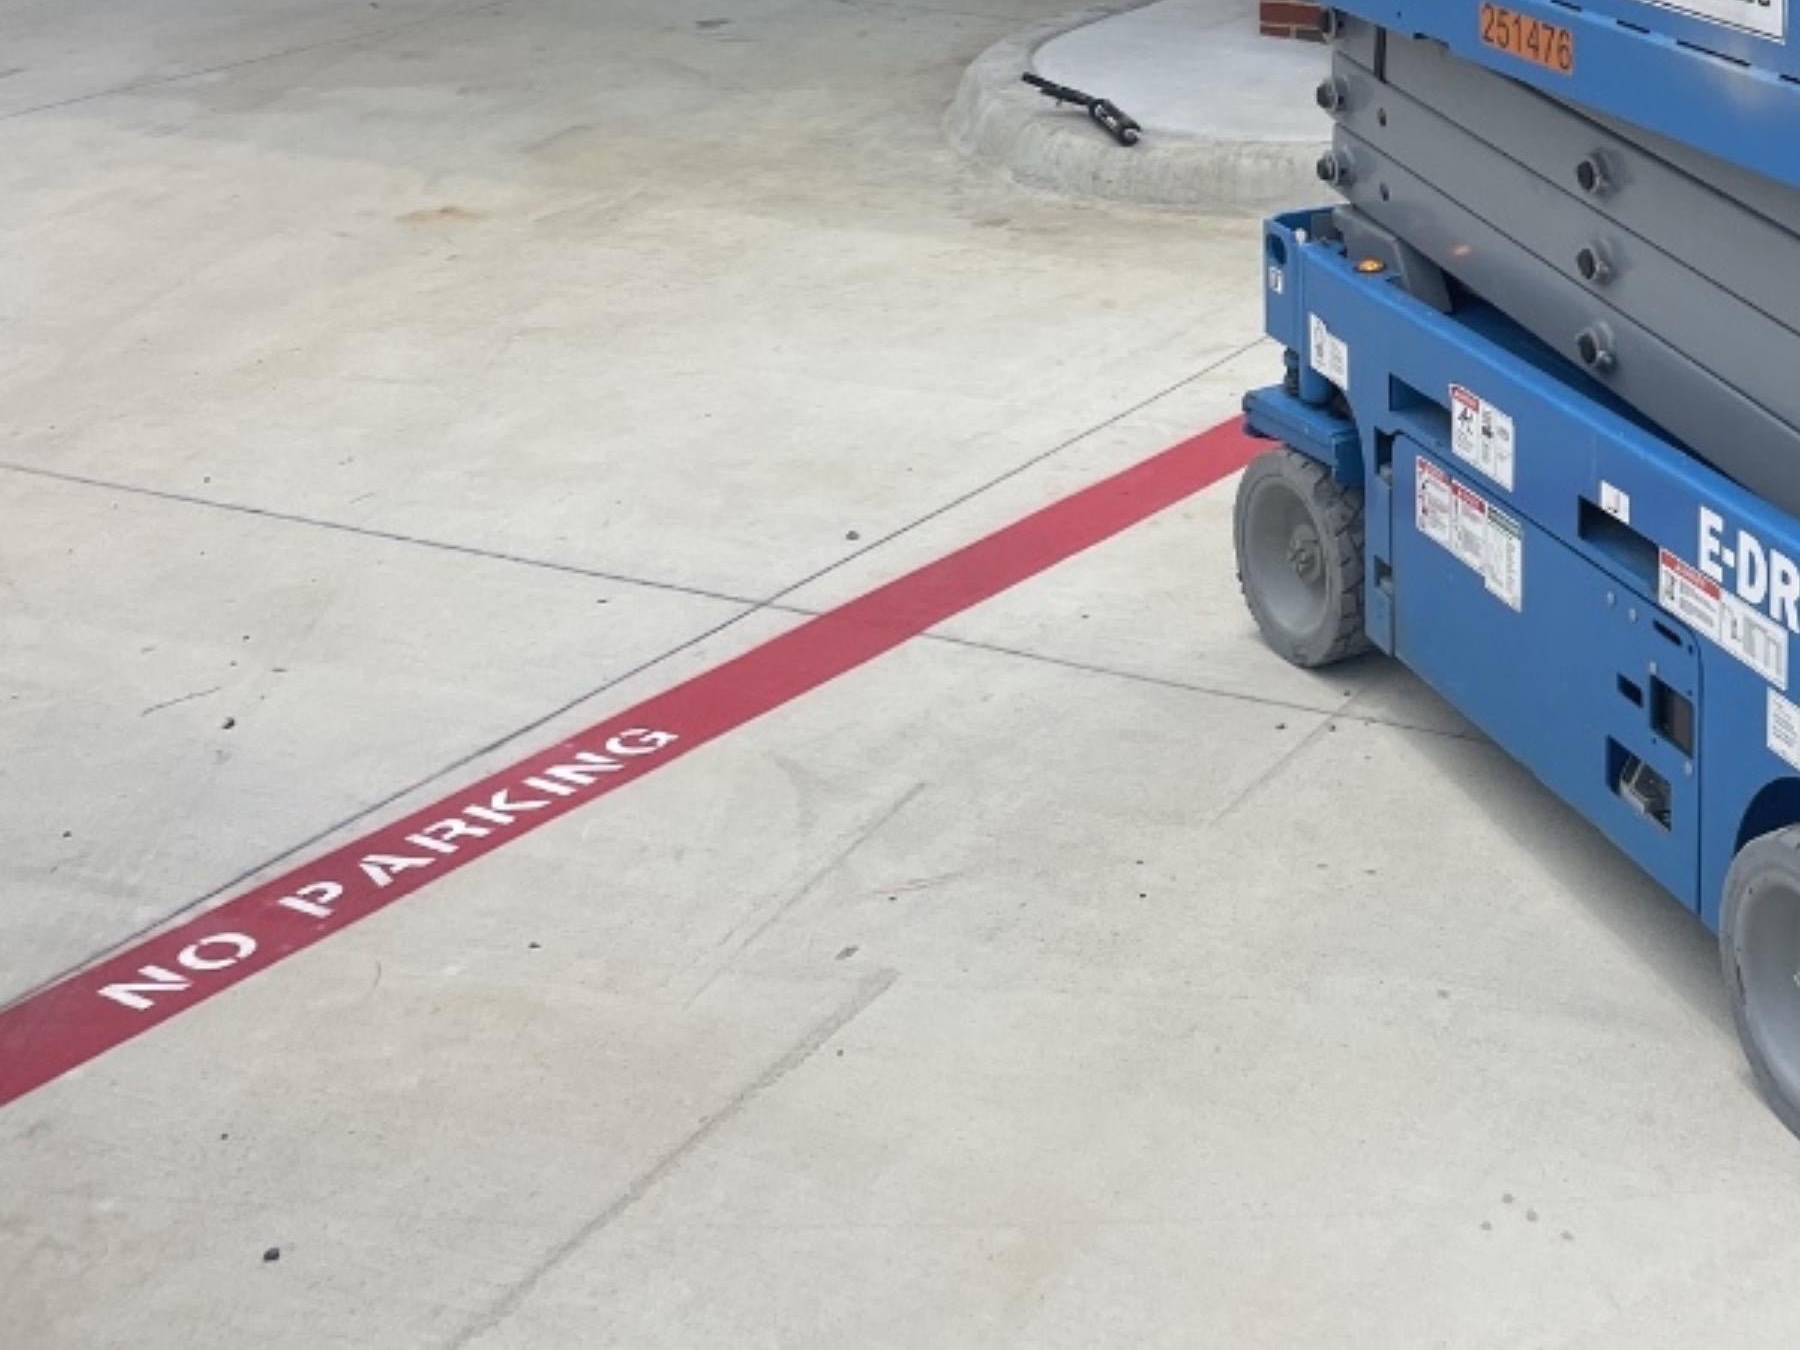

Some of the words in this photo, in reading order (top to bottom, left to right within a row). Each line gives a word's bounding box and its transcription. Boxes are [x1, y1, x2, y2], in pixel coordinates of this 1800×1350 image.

[1481, 1, 1571, 71] 251476
[97, 931, 257, 1010] NO
[278, 727, 679, 918] PARKING
